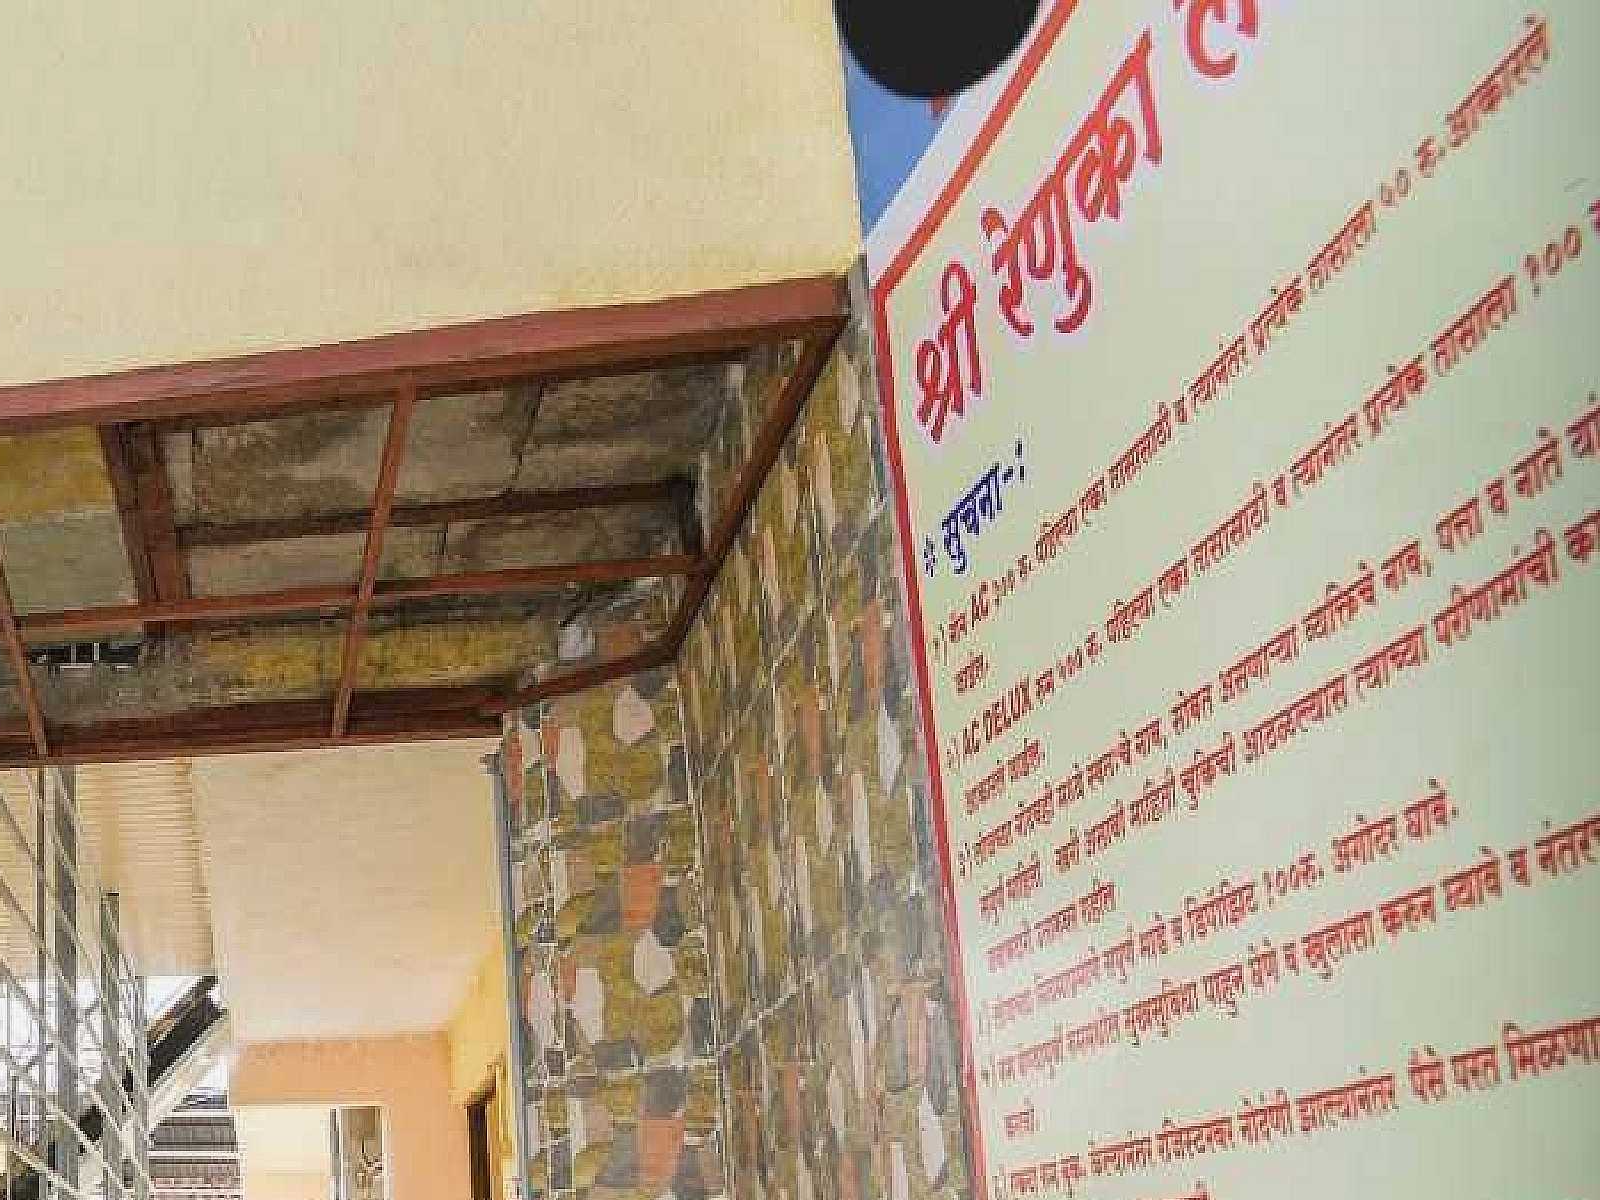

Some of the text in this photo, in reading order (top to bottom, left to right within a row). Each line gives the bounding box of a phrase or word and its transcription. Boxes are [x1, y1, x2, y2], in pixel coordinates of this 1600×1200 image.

[916, 261, 982, 443] श्री
[981, 28, 1162, 334] रेणुका
[971, 581, 989, 629] AC
[1173, 394, 1188, 425] व
[1188, 333, 1248, 413] त्यानंतर
[1248, 275, 1305, 355] प्रत्येक
[1306, 200, 1376, 294] तासाला
[1484, 477, 1508, 516] व
[1510, 428, 1563, 498] नाते
[963, 718, 981, 761] AC
[983, 676, 1033, 744] DELUX
[1104, 584, 1155, 643] पहिल्या
[1157, 555, 1189, 607] एका
[1190, 482, 1269, 572] तासासाठी
[1271, 474, 1287, 507] व
[1289, 413, 1361, 493] त्यानंतर
[1363, 353, 1427, 438] प्रत्येक
[1429, 275, 1517, 377] तासाला
[1525, 225, 1582, 297] १००
[1332, 814, 1399, 873] अगोदर
[1282, 941, 1299, 976] व
[1507, 846, 1531, 886] व
[1449, 1045, 1501, 1091] परत
